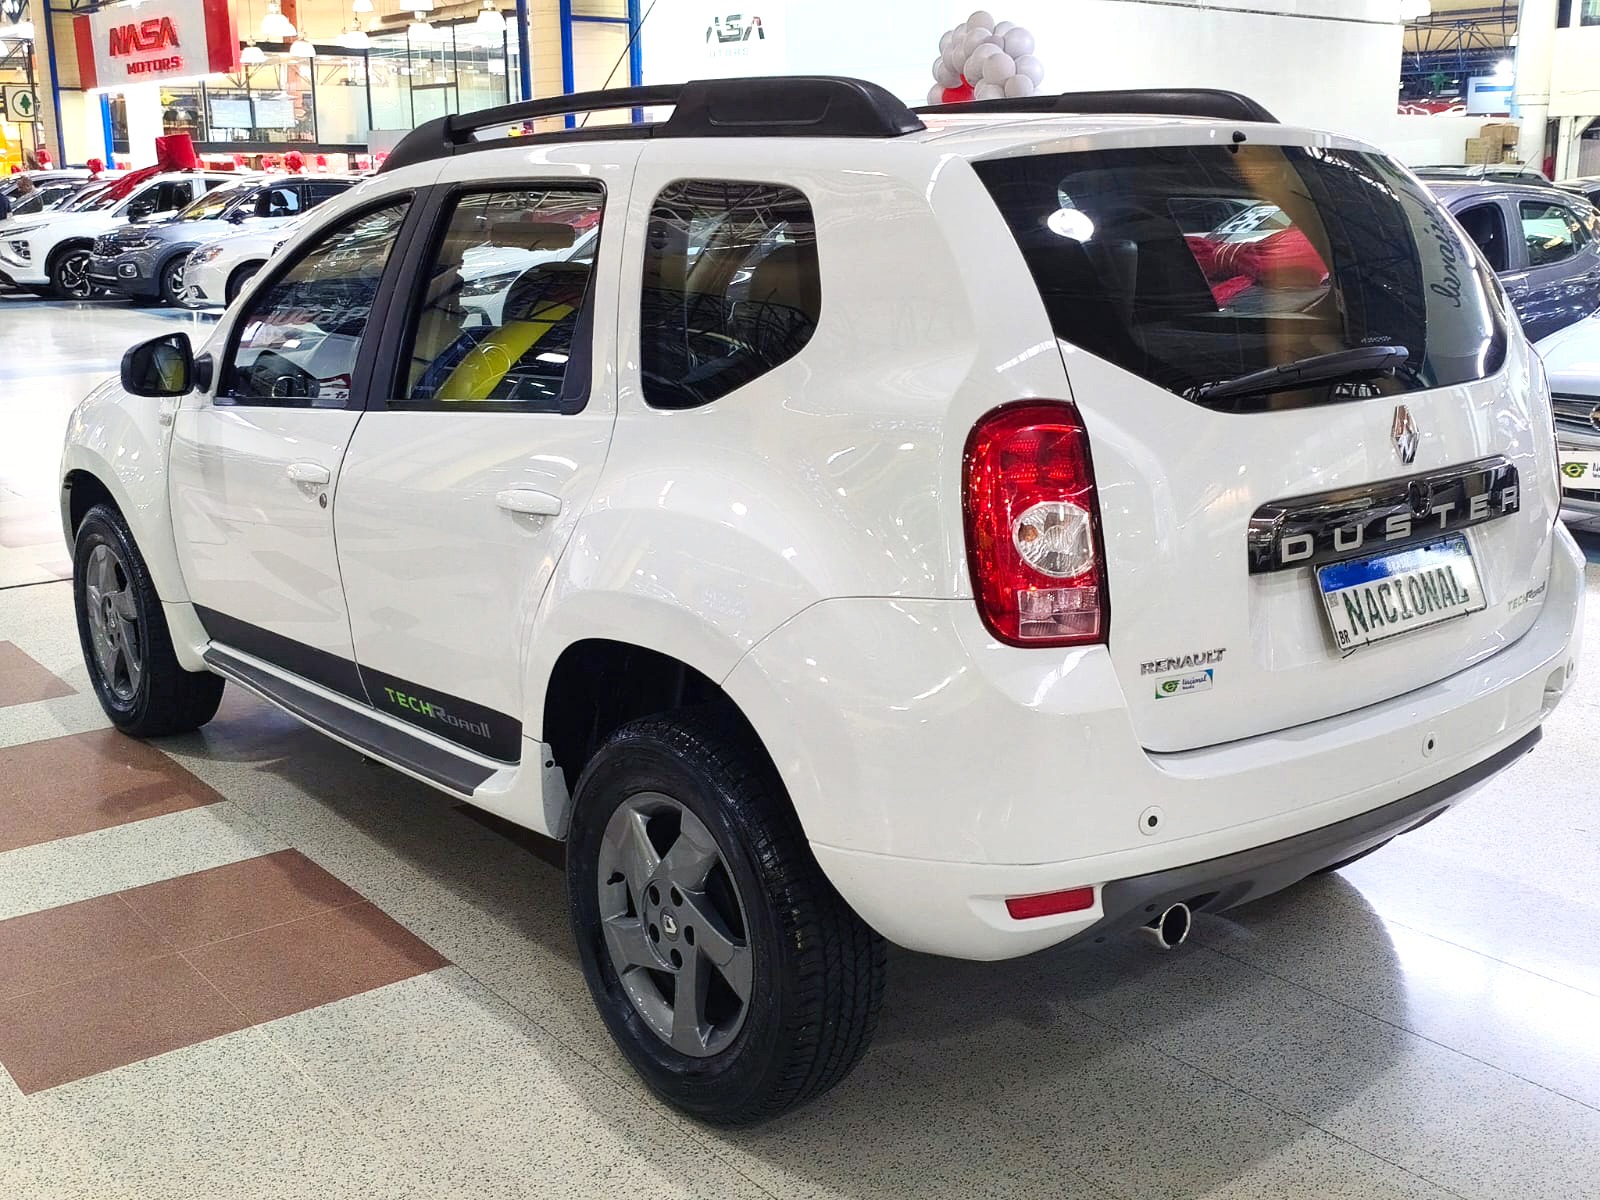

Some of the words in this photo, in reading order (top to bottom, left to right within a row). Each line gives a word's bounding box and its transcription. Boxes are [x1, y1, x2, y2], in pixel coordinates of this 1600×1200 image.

[109, 16, 180, 56] NASA
[126, 56, 182, 74] MOTORS
[1281, 485, 1520, 563] DUSTER
[1342, 565, 1470, 636] NACIONAL
[1338, 629, 1351, 645] BR
[1140, 648, 1226, 675] RENAULT
